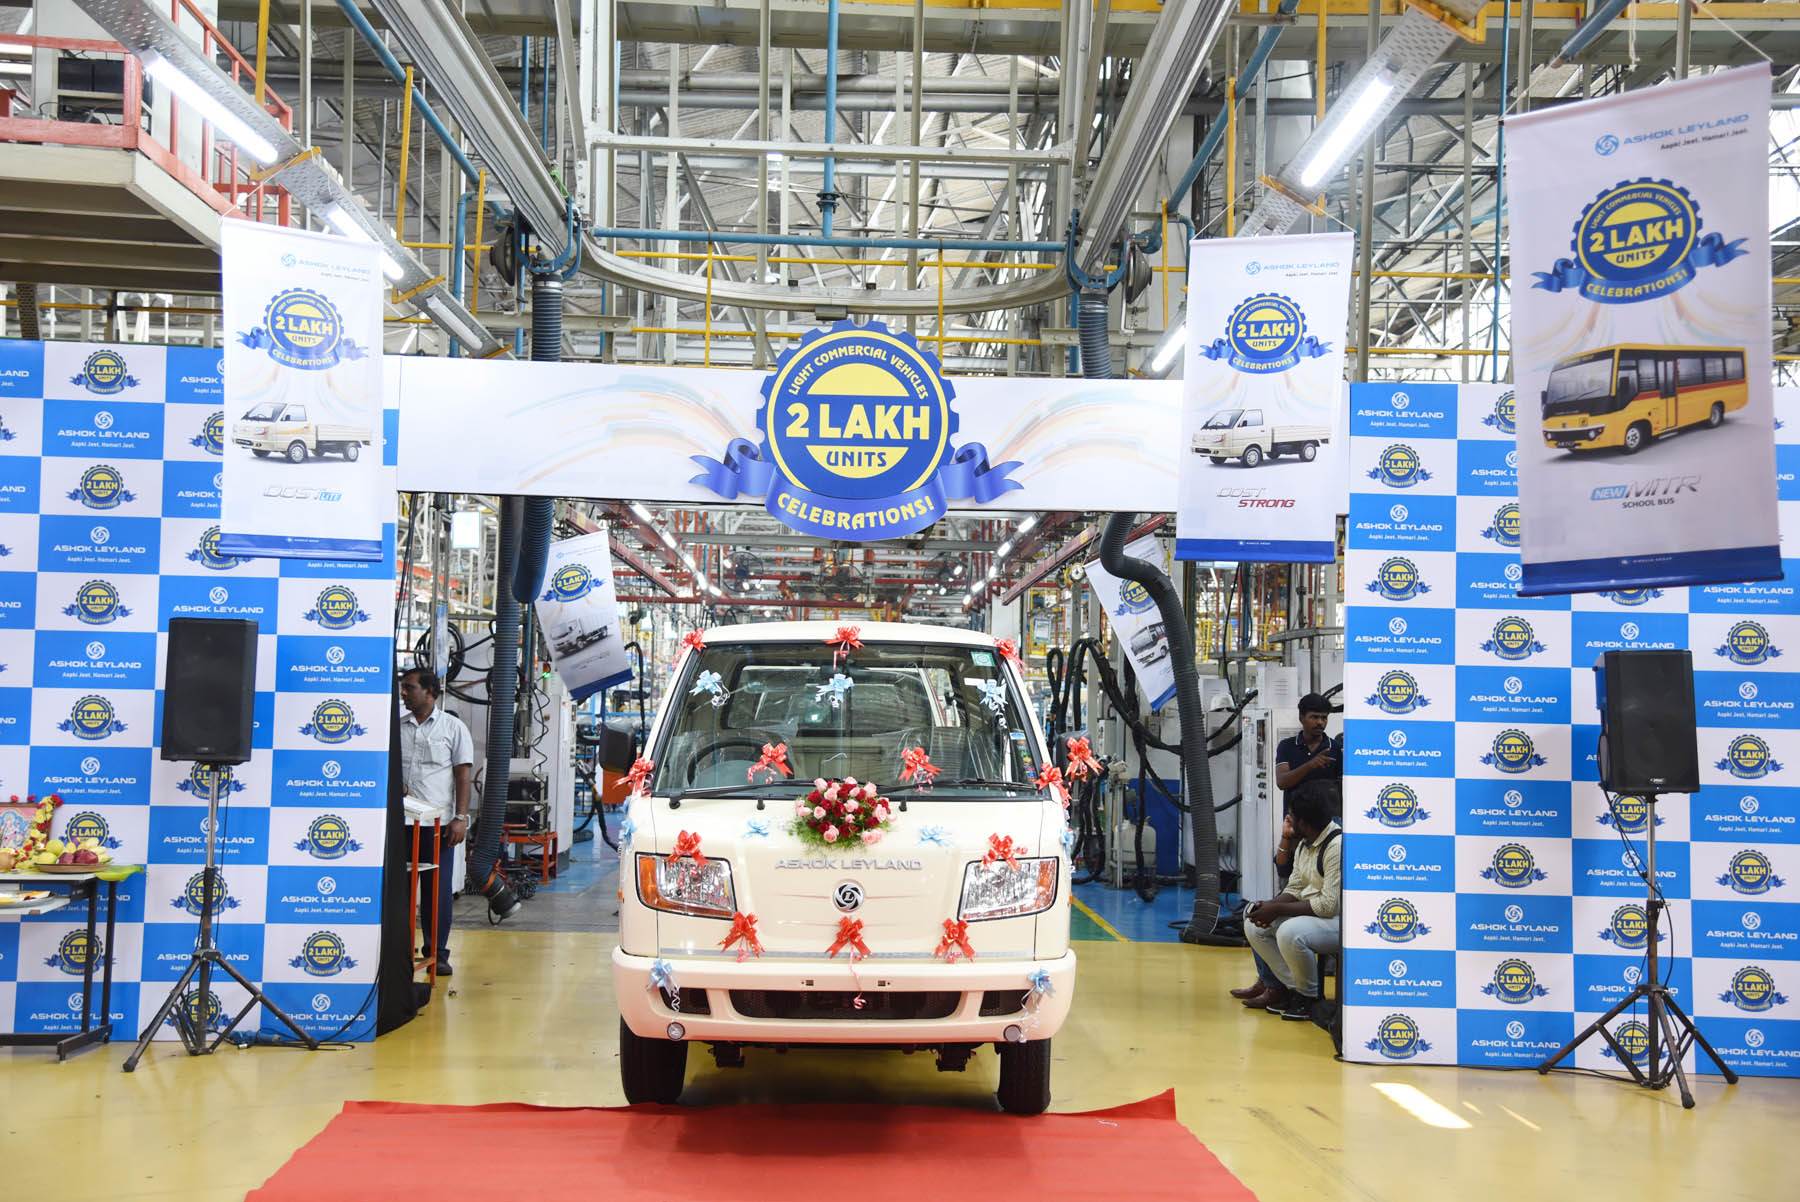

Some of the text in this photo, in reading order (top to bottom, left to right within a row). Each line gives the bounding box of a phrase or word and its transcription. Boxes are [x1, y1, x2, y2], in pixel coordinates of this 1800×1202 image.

[1624, 114, 1749, 145] ASHOK LEYLAND
[1660, 142, 1681, 151] Aapki
[1702, 132, 1729, 142] Hamari
[1590, 192, 1682, 229] LIGHT COMMERCIAL VEHICLES
[1589, 217, 1684, 253] 2 LAKH
[1616, 249, 1656, 264] UNITS
[299, 260, 371, 274] ASHOK LEYLAND
[1263, 263, 1294, 271] ASHOK
[1586, 269, 1688, 298] CELEBRATIONS!
[275, 315, 334, 334] 2 LAKH
[1236, 322, 1296, 338] 2 LAKH
[292, 335, 317, 344] UNITS
[272, 350, 335, 367] CELEBRATIONS!
[1232, 357, 1295, 370] CELEBRATIONS!
[0, 369, 30, 378] LAND
[96, 366, 122, 375] LAKH
[788, 345, 928, 400] LIGHT COMMERCIAL VEHICLES
[180, 376, 219, 385] ASHOK
[1356, 409, 1445, 419] ASHOK LEYLAND
[785, 402, 930, 440] 2 LAKH
[57, 429, 150, 439] ASHOK LEYLAND
[826, 451, 887, 467] UNITS
[1390, 460, 1415, 469] LAKH
[1471, 468, 1508, 477] ASHOK
[92, 481, 119, 490] LAKH
[1593, 475, 1702, 499] NEW MITR
[177, 490, 215, 498] ASHOK
[1238, 499, 1296, 508] STRONG
[1622, 497, 1675, 509] SCHOOL BUS
[777, 493, 935, 530] CELEBRATIONS!
[1355, 522, 1443, 532] ASHOK LEYLAND
[53, 544, 146, 554] ASHOK LEYLAND
[563, 575, 586, 587] LAKH
[1469, 581, 1507, 590] ASHOK
[1703, 586, 1794, 595] ASHOK LEYLAND
[88, 596, 114, 605] LAKH
[328, 601, 353, 610] LAKH
[172, 604, 265, 614] ASHOK LEYLAND
[1354, 635, 1442, 645] ASHOK LEYLAND
[1504, 632, 1529, 641] LAKH
[1739, 636, 1764, 646] LAKH
[1585, 640, 1676, 650] ASHOK LEYLAND
[47, 660, 142, 669] ASHOK LEYLAND
[290, 664, 381, 674] ASHOK LEYLAND
[1389, 686, 1414, 695] LAKH
[1469, 694, 1558, 704] ASHOK LEYLAND
[1703, 700, 1795, 709] ASHOK LEYLAND
[83, 711, 110, 720] LAKH
[324, 715, 350, 724] LAKH
[1353, 748, 1442, 758] ASHOK LEYLAND
[43, 776, 137, 785] ASHOK LEYLAND
[286, 779, 377, 788] ASHOK LEYLAND
[1469, 808, 1558, 817] ASHOK LEYLAND
[1704, 814, 1796, 824] ASHOK LEYLAND
[319, 830, 345, 840] LAKH
[163, 836, 201, 845] ASHOK
[775, 858, 922, 871] ASHOK LEYLAND
[1353, 862, 1442, 872] ASHOK LEYLAND
[1504, 859, 1529, 869] LAKH
[1741, 866, 1767, 875] LAKH
[280, 895, 372, 904] ASHOK LEYLAND
[1388, 913, 1414, 923] LAKH
[1469, 923, 1559, 933] ASHOK LEYLAND
[1705, 930, 1798, 940] ASHOK LEYLAND
[1353, 978, 1443, 987] ASHOK LEYLAND
[1471, 1039, 1561, 1049] ASHOK LEYLAND
